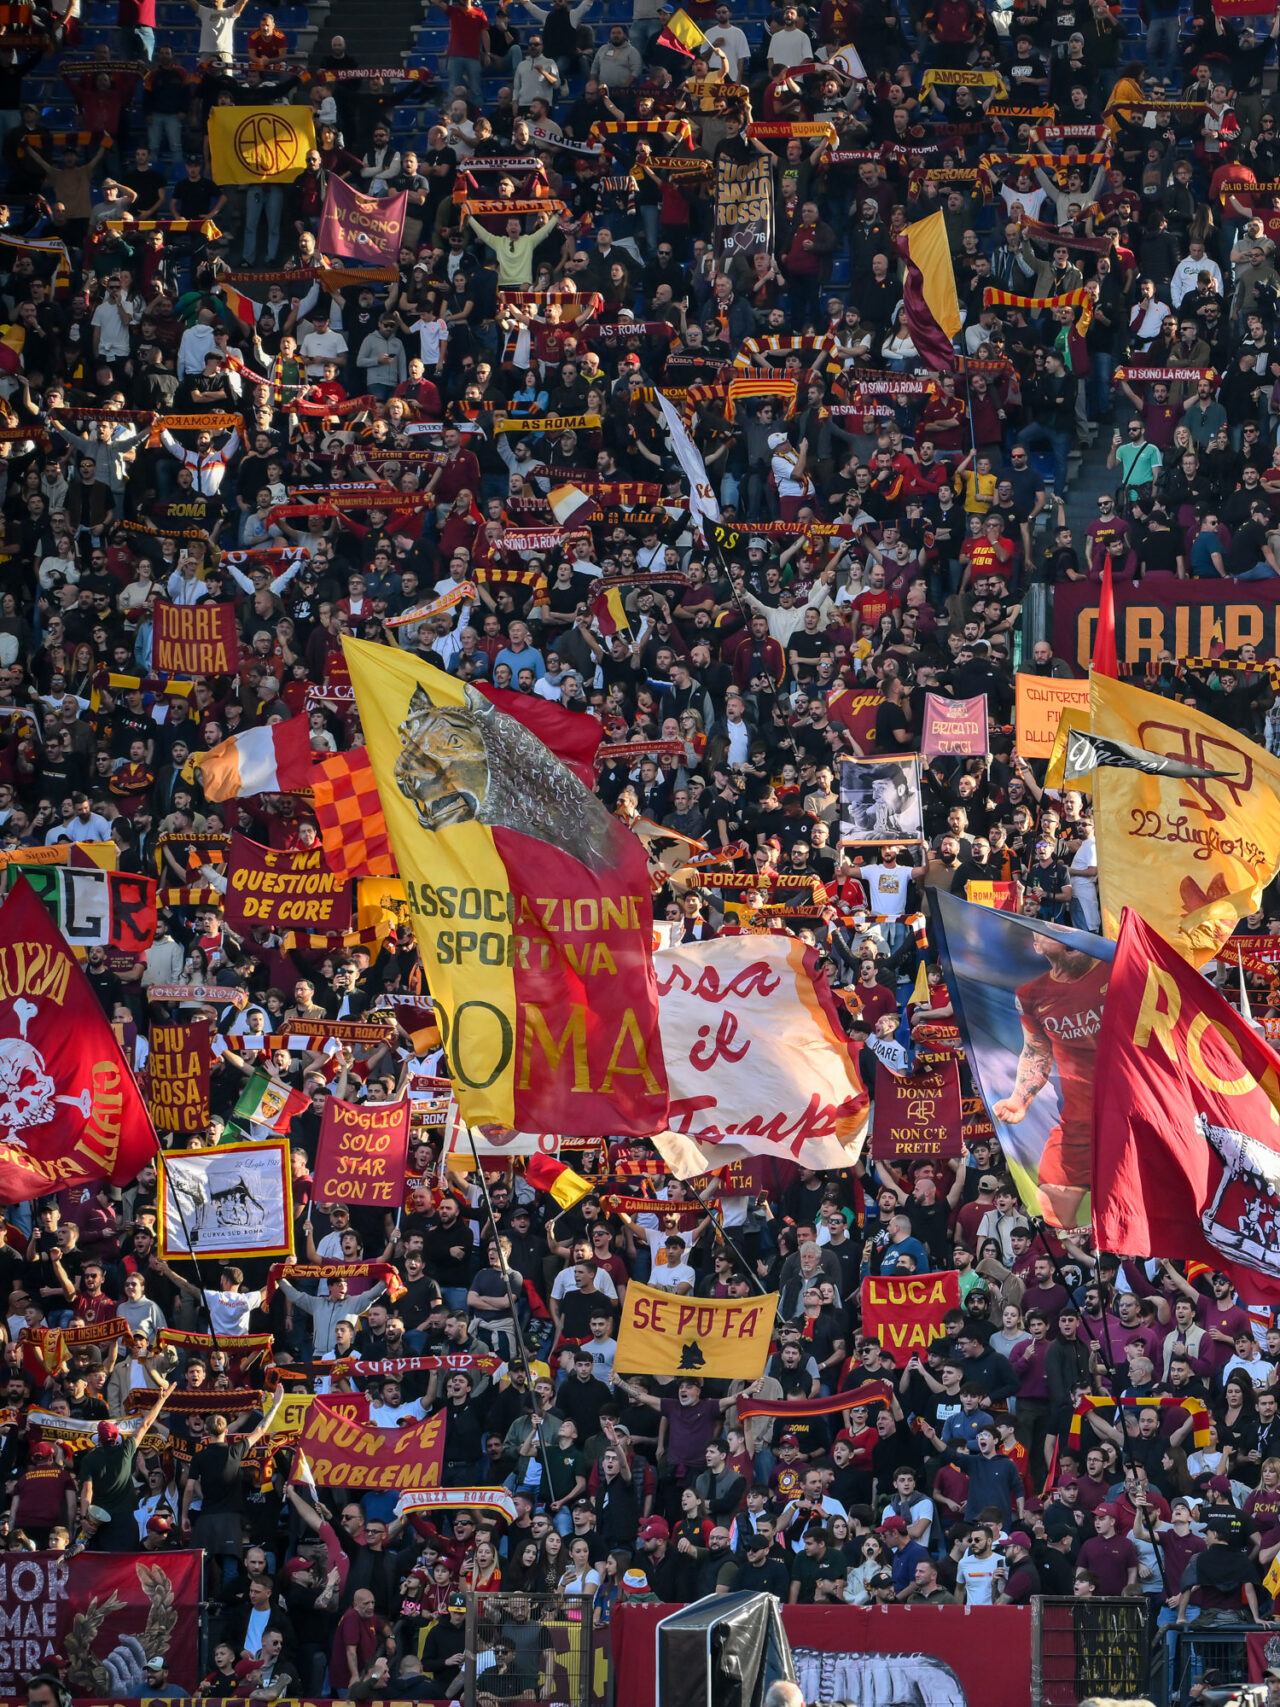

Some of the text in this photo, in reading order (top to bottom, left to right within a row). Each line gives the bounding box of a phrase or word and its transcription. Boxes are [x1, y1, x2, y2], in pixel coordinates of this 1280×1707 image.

[370, 69, 380, 78] LA
[381, 68, 405, 78] ROMA
[1045, 125, 1096, 137] AS ROMA
[926, 167, 978, 181] ASROMA
[352, 210, 400, 234] GIORNO
[717, 200, 770, 226] ROSSO
[723, 233, 766, 248] 19 76
[600, 323, 647, 337] AS ROMA
[1137, 369, 1201, 380] SONO LA ROMA
[868, 381, 923, 394] SONO LA ROMA
[521, 416, 587, 430] AS ROMA
[299, 482, 377, 491] A.S.ROMA
[374, 496, 403, 505] INSIEME
[167, 504, 207, 518] ROMA
[775, 522, 808, 532] ROMA
[504, 538, 539, 550] SONO LA
[160, 605, 222, 641] TORRE
[158, 640, 229, 673] MAURA
[932, 721, 979, 735] BRIGATA
[169, 833, 193, 841] SOLO
[1129, 809, 1236, 861] 22 Luglio
[232, 868, 345, 894] QUESTIONE
[703, 874, 755, 888] FORZA
[243, 897, 334, 922] DE CORE
[407, 880, 644, 932] ASSOCIAZIONE
[436, 930, 618, 977] SPORTIVA
[1044, 1004, 1104, 1033] QATA
[152, 1026, 192, 1054] PIU'
[295, 1023, 386, 1039] ROMA TIFA ROMA
[1061, 1023, 1101, 1041] AIRWA
[690, 1009, 752, 1072] il
[149, 1051, 202, 1079] BELLA
[896, 1087, 943, 1100] DONNA
[333, 1103, 404, 1130] VOGLIO
[890, 1125, 948, 1141] NON C'È
[339, 1132, 391, 1153] SOLO
[895, 1142, 941, 1154] PRETE
[336, 1156, 387, 1177] STAR
[323, 1178, 396, 1201] CON TE
[282, 1264, 370, 1279] ASROMA
[869, 1280, 948, 1306] LUCA
[632, 1297, 669, 1334] SE
[77, 1323, 108, 1341] INSIEME
[877, 1322, 946, 1349] IVAN
[355, 1355, 421, 1374] CURVA
[305, 1410, 386, 1457] NUN
[410, 1490, 495, 1505] FORZA ROMA
